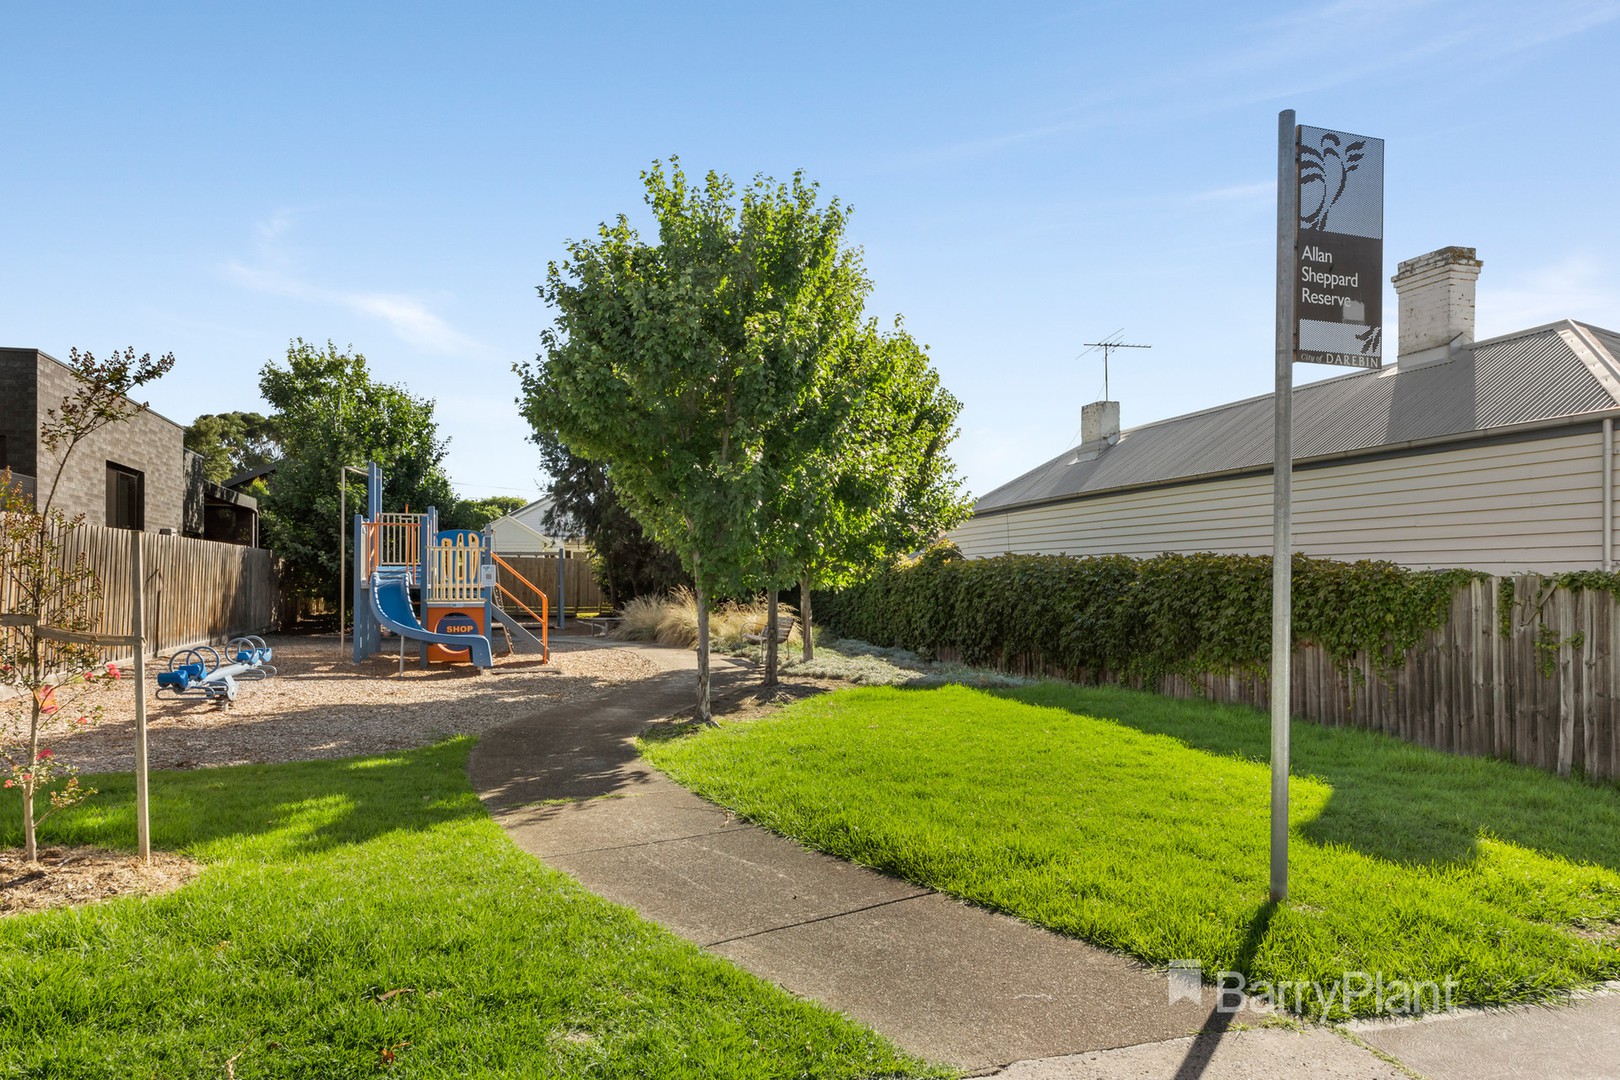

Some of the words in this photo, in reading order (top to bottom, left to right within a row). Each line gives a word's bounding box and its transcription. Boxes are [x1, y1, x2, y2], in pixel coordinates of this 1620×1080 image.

[1302, 245, 1332, 263] Allan
[1301, 266, 1358, 289] Sheppard
[1302, 287, 1351, 307] Reserve
[1301, 353, 1315, 363] City
[1315, 354, 1323, 362] of
[1326, 353, 1379, 368] DAREBIN
[446, 625, 473, 633] SHOP
